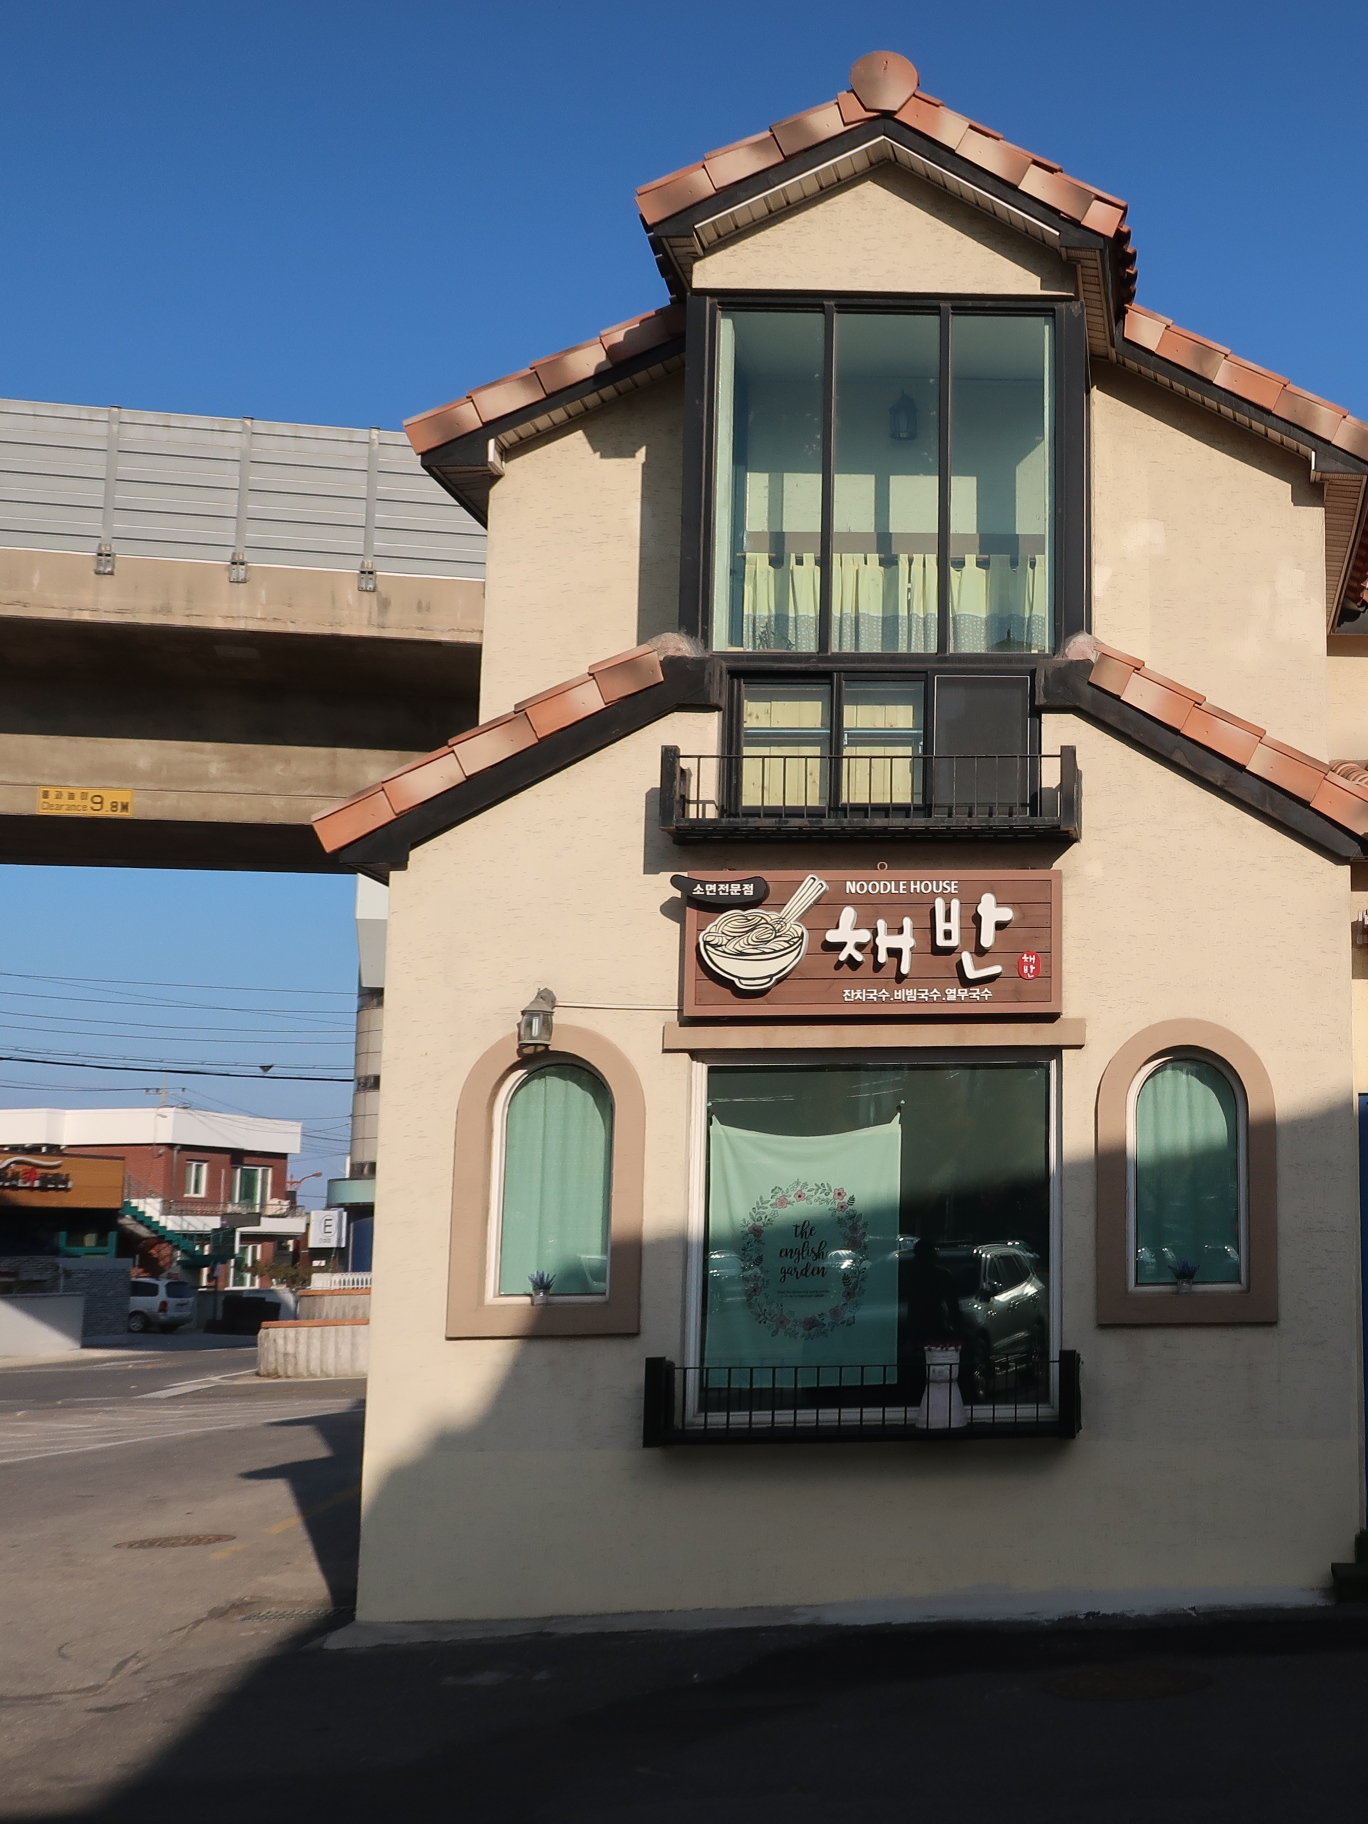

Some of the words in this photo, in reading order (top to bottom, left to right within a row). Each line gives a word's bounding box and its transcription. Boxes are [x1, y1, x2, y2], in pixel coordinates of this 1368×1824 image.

[41, 801, 88, 811] Clearance
[692, 882, 755, 897] 소면전문점
[845, 880, 908, 895] NOODLE
[909, 880, 959, 894] HOUSE
[825, 892, 1014, 980] 채반
[792, 1219, 818, 1240] the
[779, 1240, 829, 1264] english
[779, 1261, 829, 1284] garden
